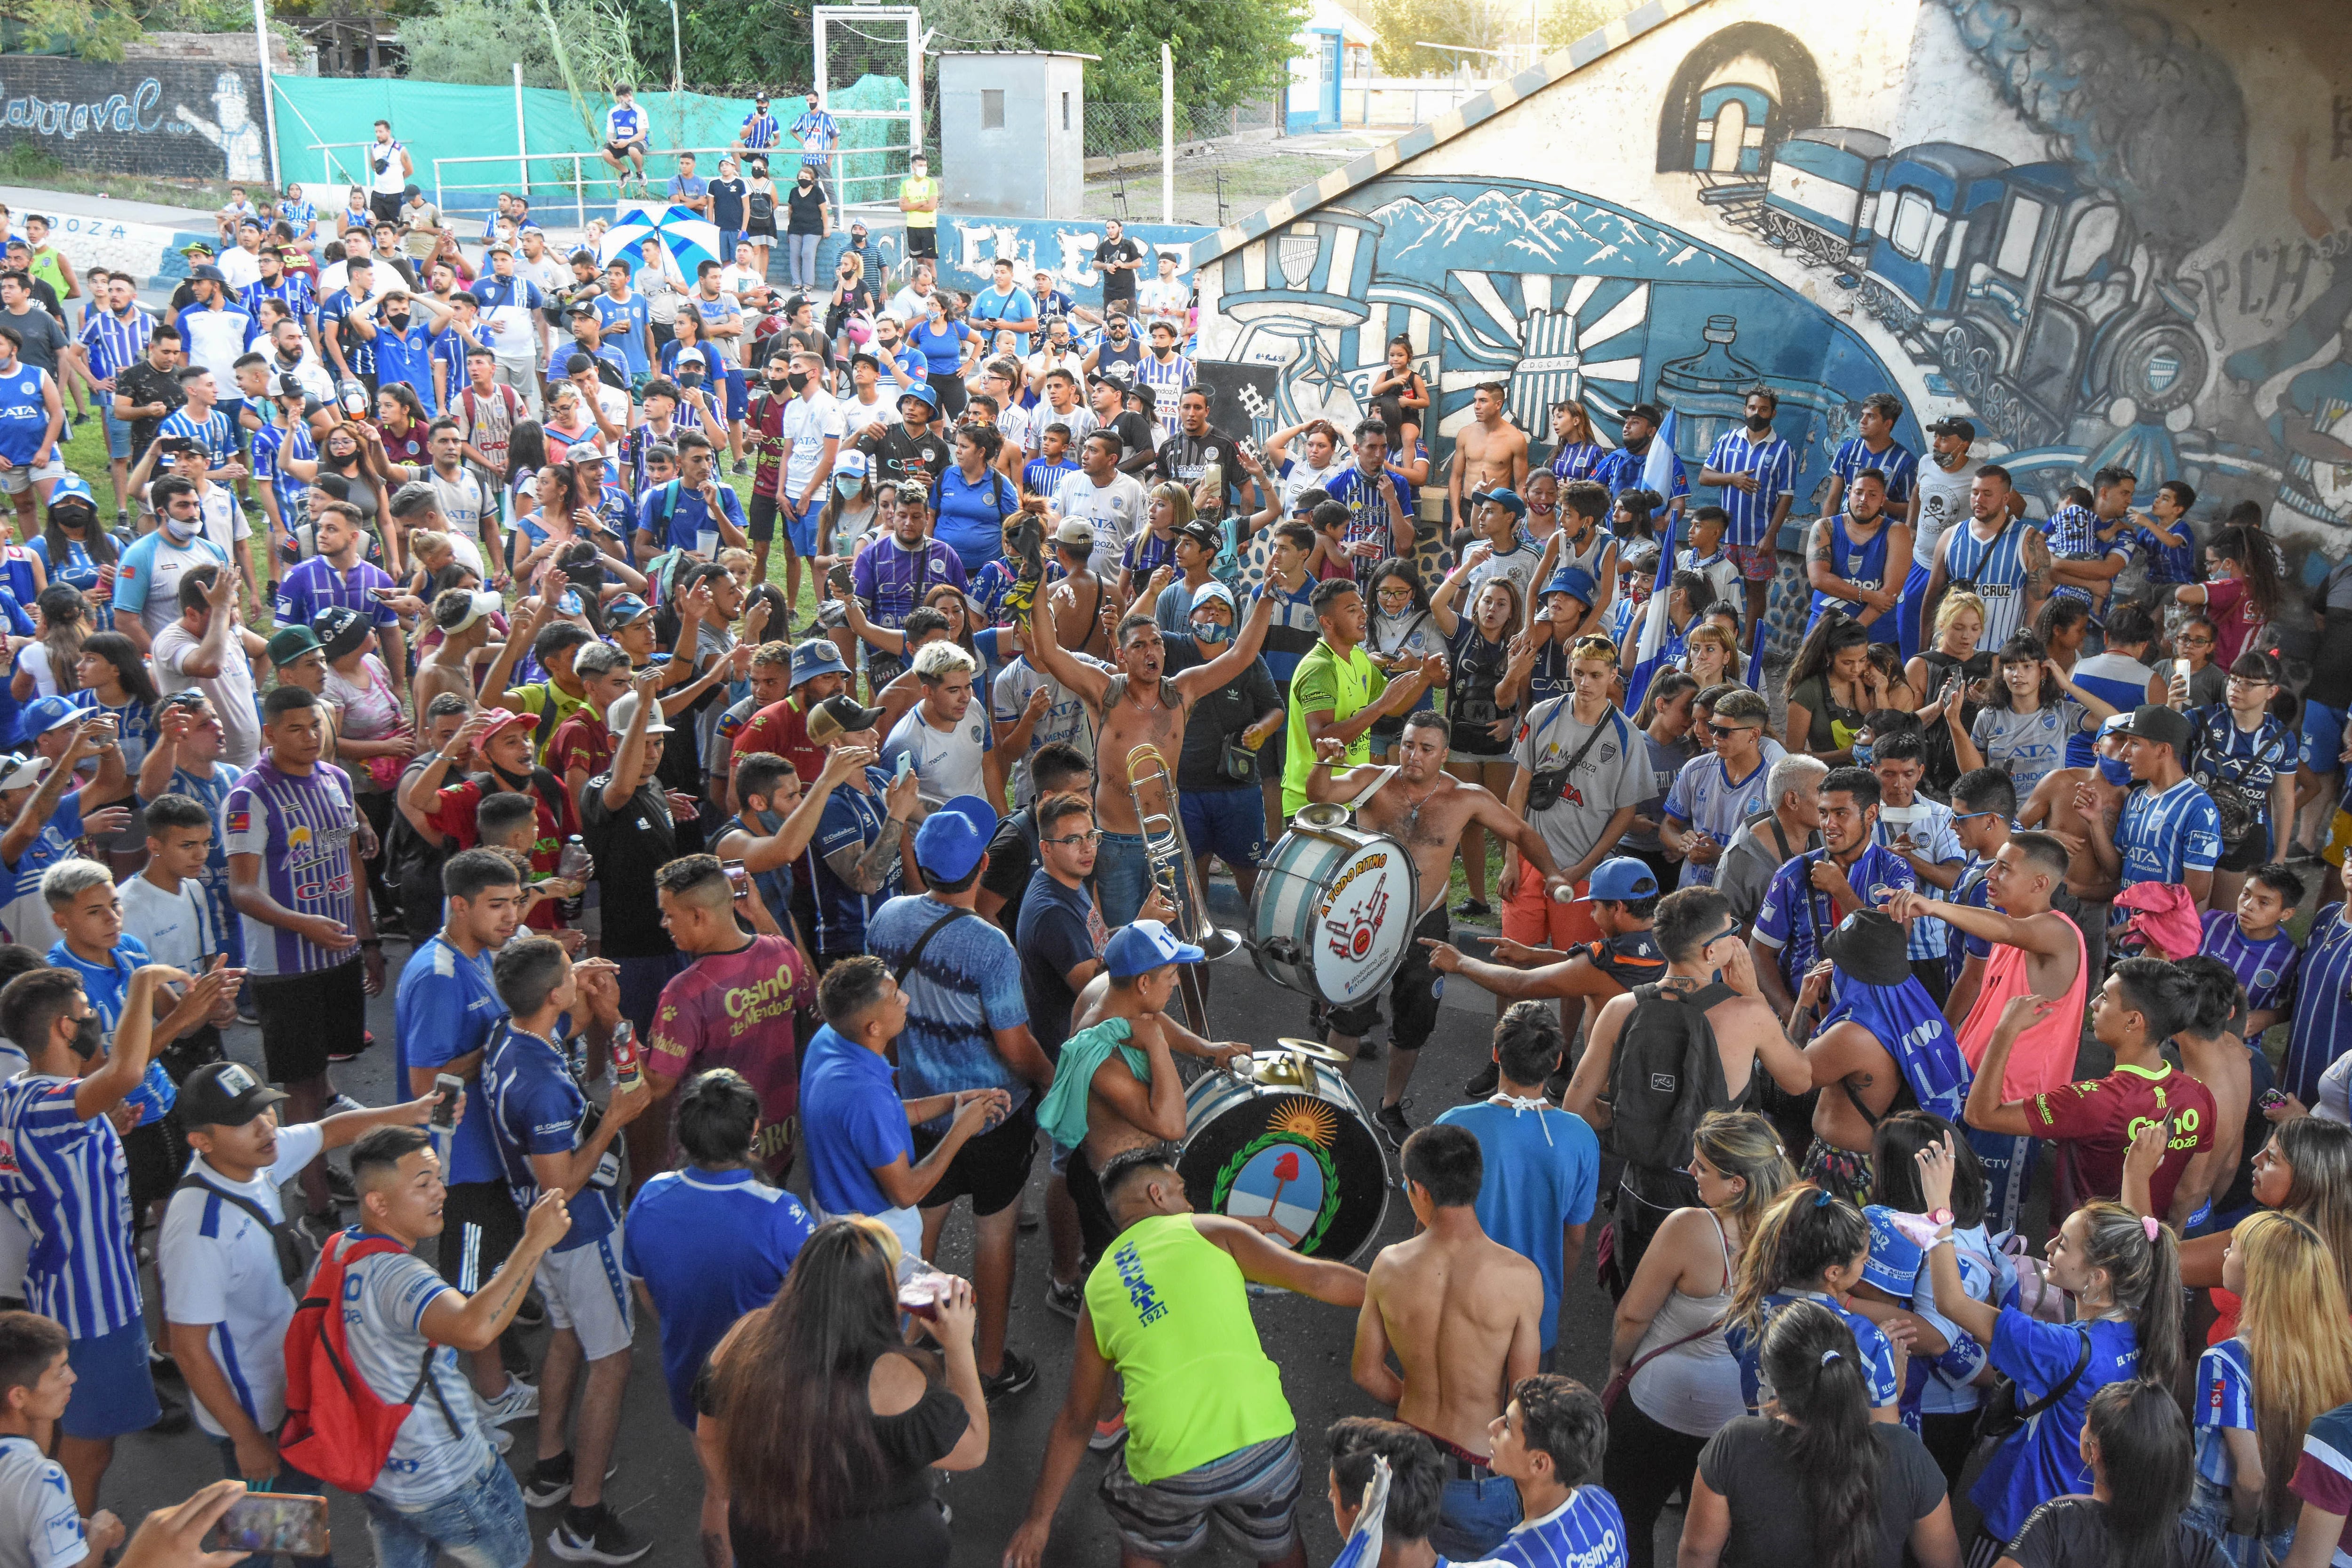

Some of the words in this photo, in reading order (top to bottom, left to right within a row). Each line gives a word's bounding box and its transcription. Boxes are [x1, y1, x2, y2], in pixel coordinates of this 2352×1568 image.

[1980, 585, 2009, 597] CRUZ
[929, 751, 947, 767] macron
[1988, 744, 2057, 761] CATA
[1321, 905, 1332, 918] A
[1327, 868, 1355, 905] TODO
[1356, 853, 1387, 878] RITMO
[2210, 949, 2231, 963] KELME
[2070, 1084, 2084, 1099] KELME
[1140, 1305, 1169, 1328] 1921
[1956, 1343, 1974, 1364] KELME
